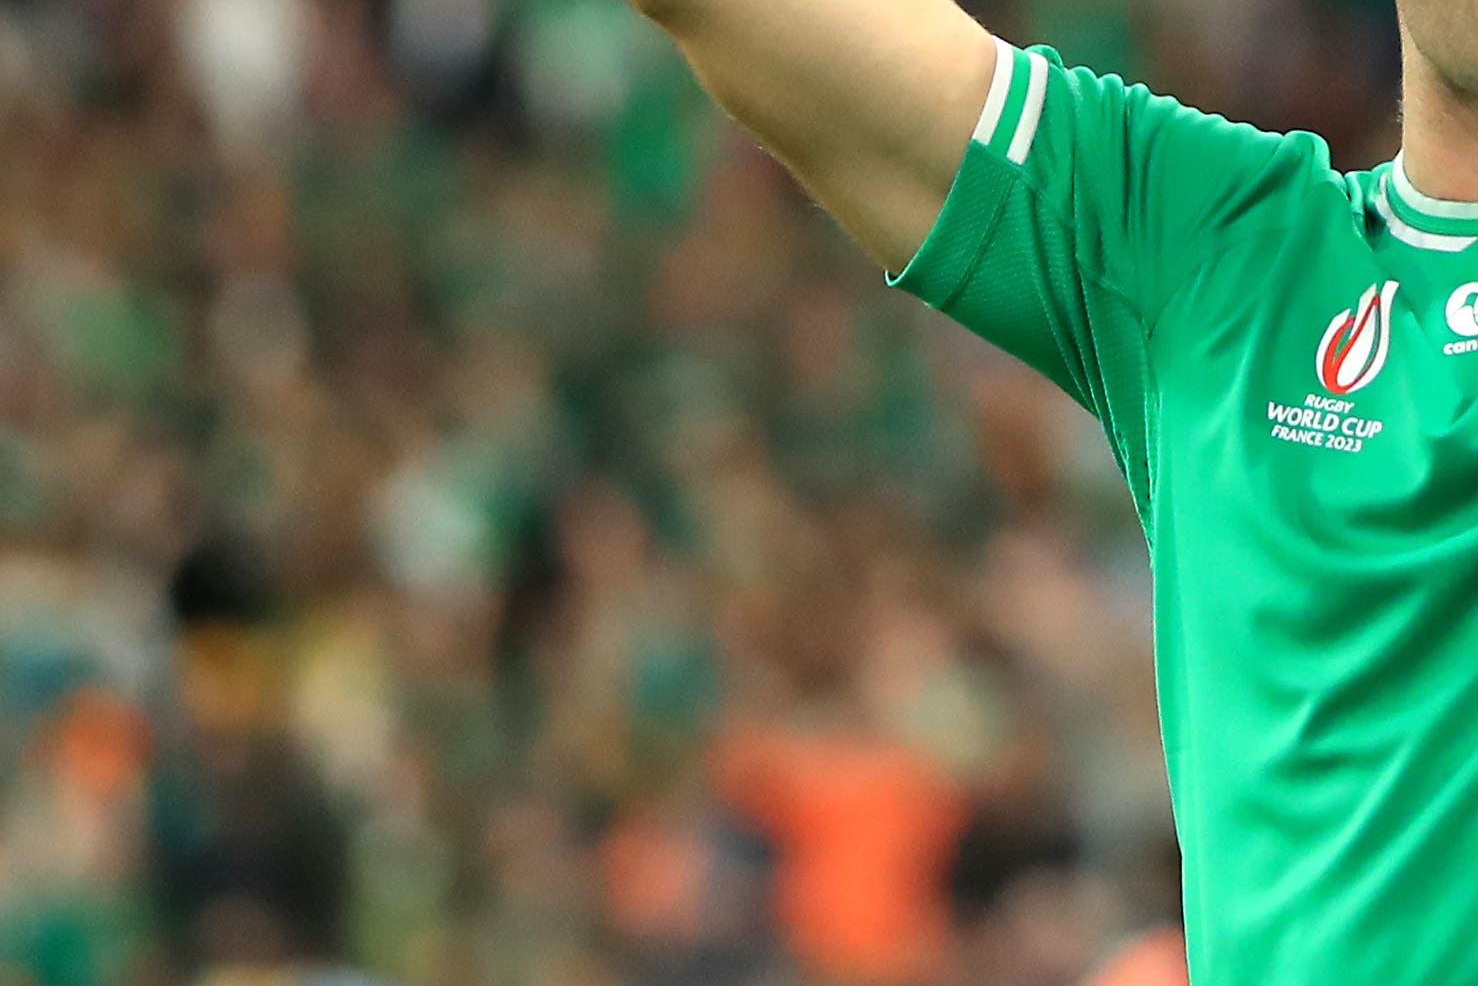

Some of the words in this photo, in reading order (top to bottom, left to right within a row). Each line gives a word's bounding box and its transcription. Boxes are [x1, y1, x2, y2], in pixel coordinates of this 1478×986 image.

[1304, 394, 1355, 414] RUGBY
[1268, 401, 1340, 432] WORLD
[1341, 417, 1383, 438] CUP
[1271, 424, 1324, 446] FRANCE
[1325, 434, 1362, 452] 2023
